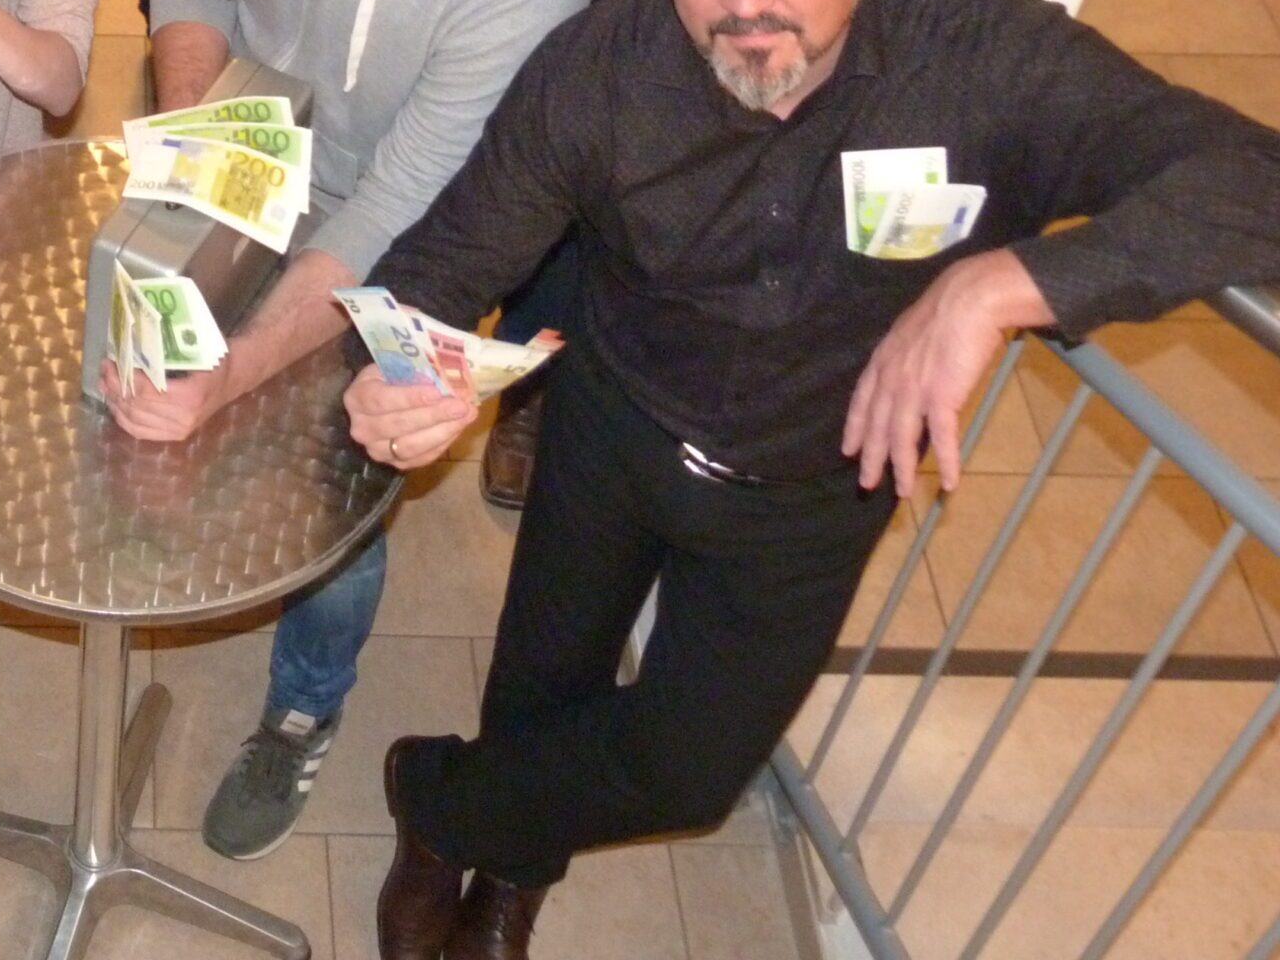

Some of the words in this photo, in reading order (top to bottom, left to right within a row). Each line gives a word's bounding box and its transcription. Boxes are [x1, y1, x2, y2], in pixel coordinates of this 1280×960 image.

[222, 102, 272, 123] 100
[239, 127, 290, 153] 100
[232, 151, 285, 187] 200
[390, 325, 420, 358] 20
